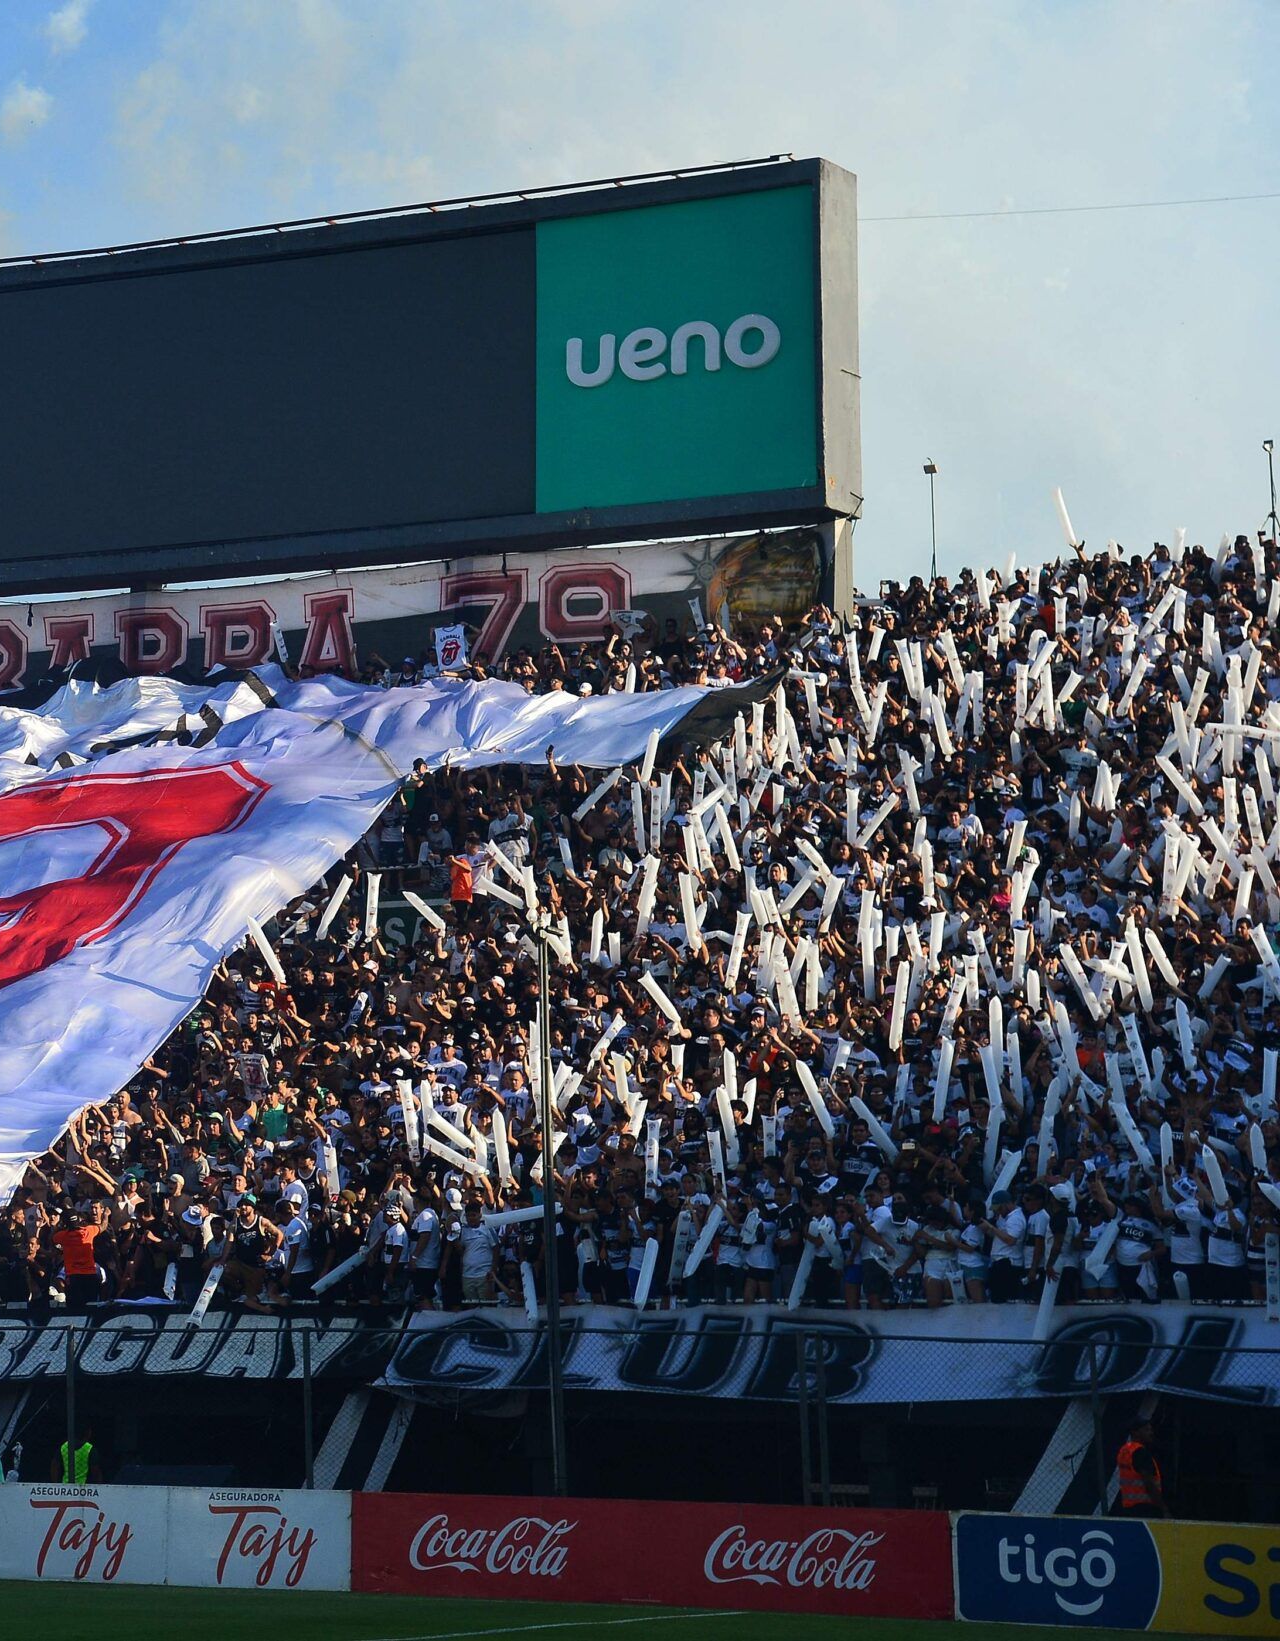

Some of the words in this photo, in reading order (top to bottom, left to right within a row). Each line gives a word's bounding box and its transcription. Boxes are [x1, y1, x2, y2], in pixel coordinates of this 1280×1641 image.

[566, 313, 781, 388] ueno
[387, 1316, 877, 1399] CLUB
[30, 1487, 99, 1497] ASEGURADORA
[208, 1491, 281, 1502] ASEGURADORA
[30, 1499, 133, 1580] Tajy
[208, 1504, 317, 1588] Tajy
[409, 1514, 579, 1576] Coca-Cola
[704, 1525, 886, 1590] Coca-Cola
[1204, 1543, 1280, 1620] S
